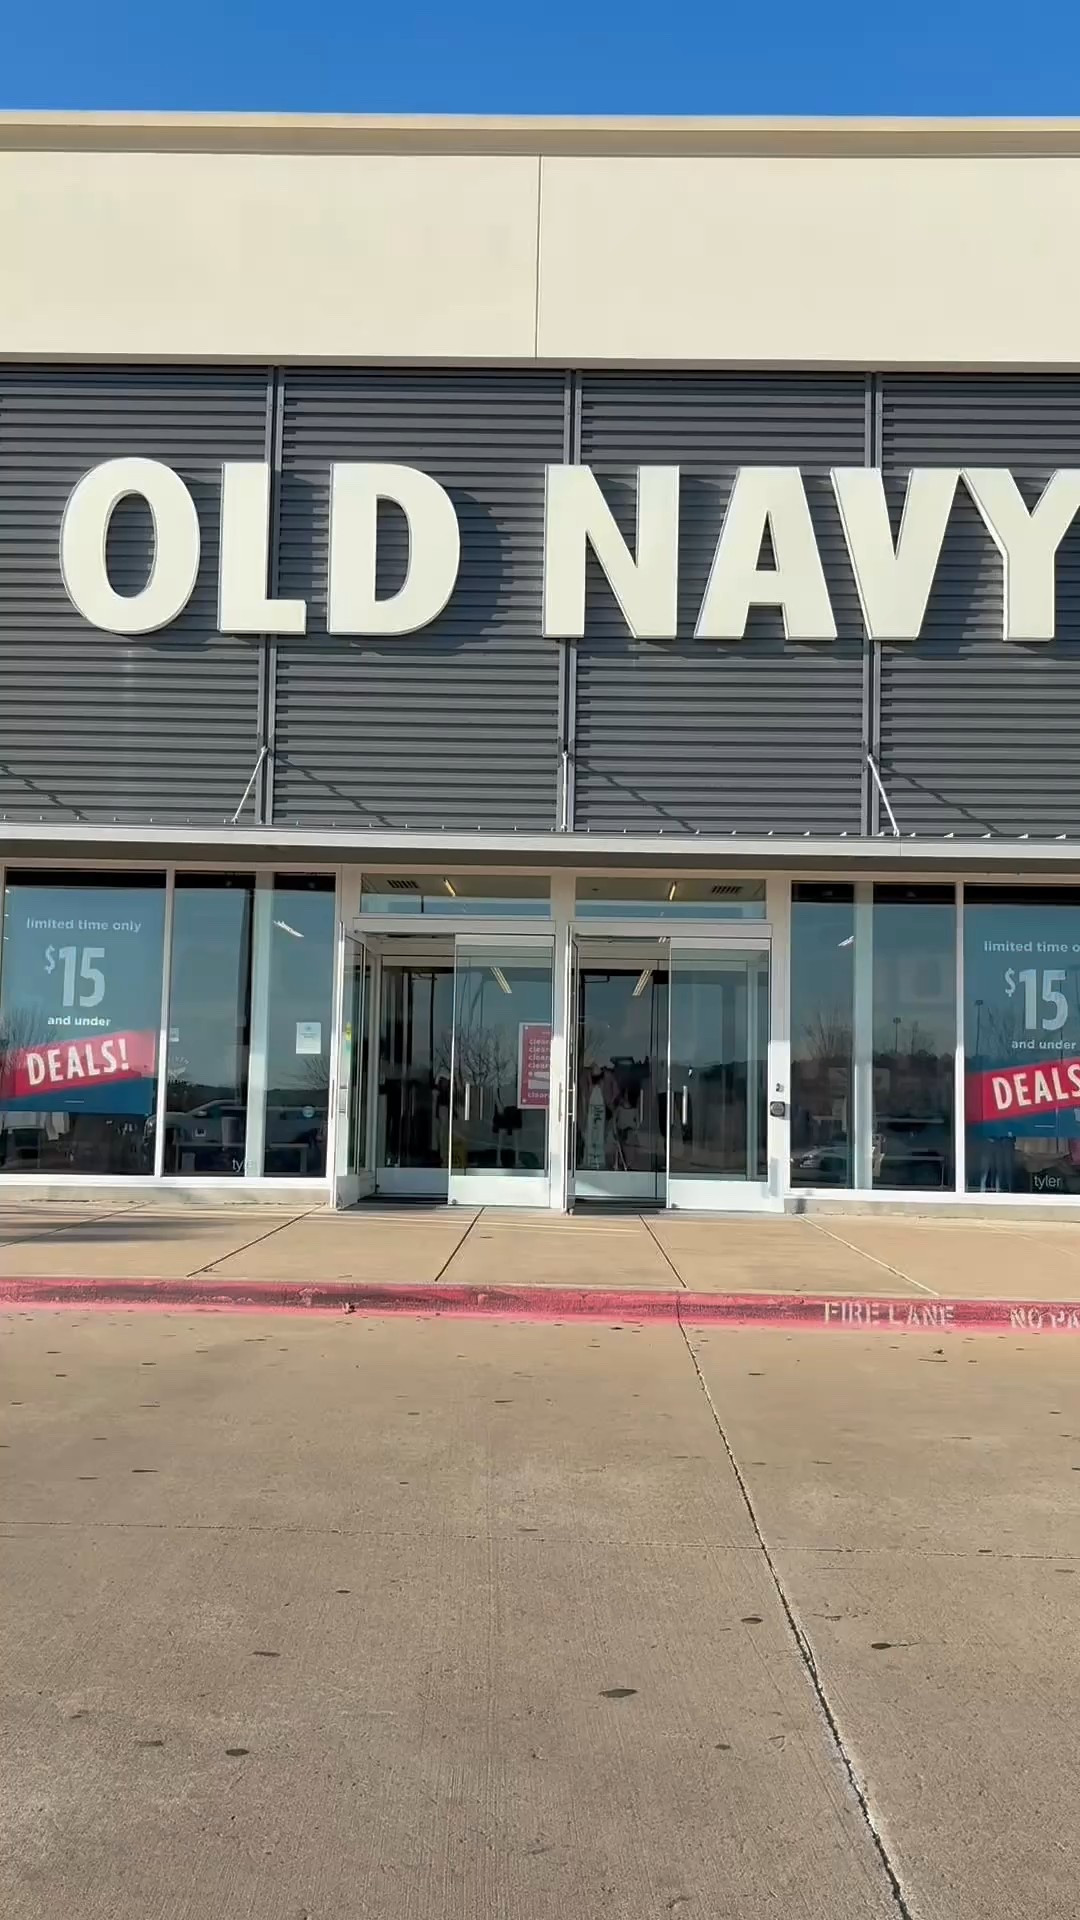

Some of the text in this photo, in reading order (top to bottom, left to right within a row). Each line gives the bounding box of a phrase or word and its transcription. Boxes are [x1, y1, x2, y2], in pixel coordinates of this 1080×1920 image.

[61, 456, 1080, 642] OLD NAVY
[27, 917, 142, 933] limited time only
[984, 940, 1033, 953] limited
[1037, 941, 1068, 953] time
[44, 944, 106, 1008] $15
[1004, 967, 1069, 1031] $15
[47, 1015, 112, 1028] and under
[1012, 1039, 1077, 1051] and under
[26, 1038, 129, 1086] DEALS!
[992, 1063, 1080, 1111] DEALS
[1034, 1175, 1062, 1190] tyler
[824, 1302, 880, 1325] FIRE
[889, 1303, 956, 1327] LANE
[1010, 1307, 1042, 1329] NO
